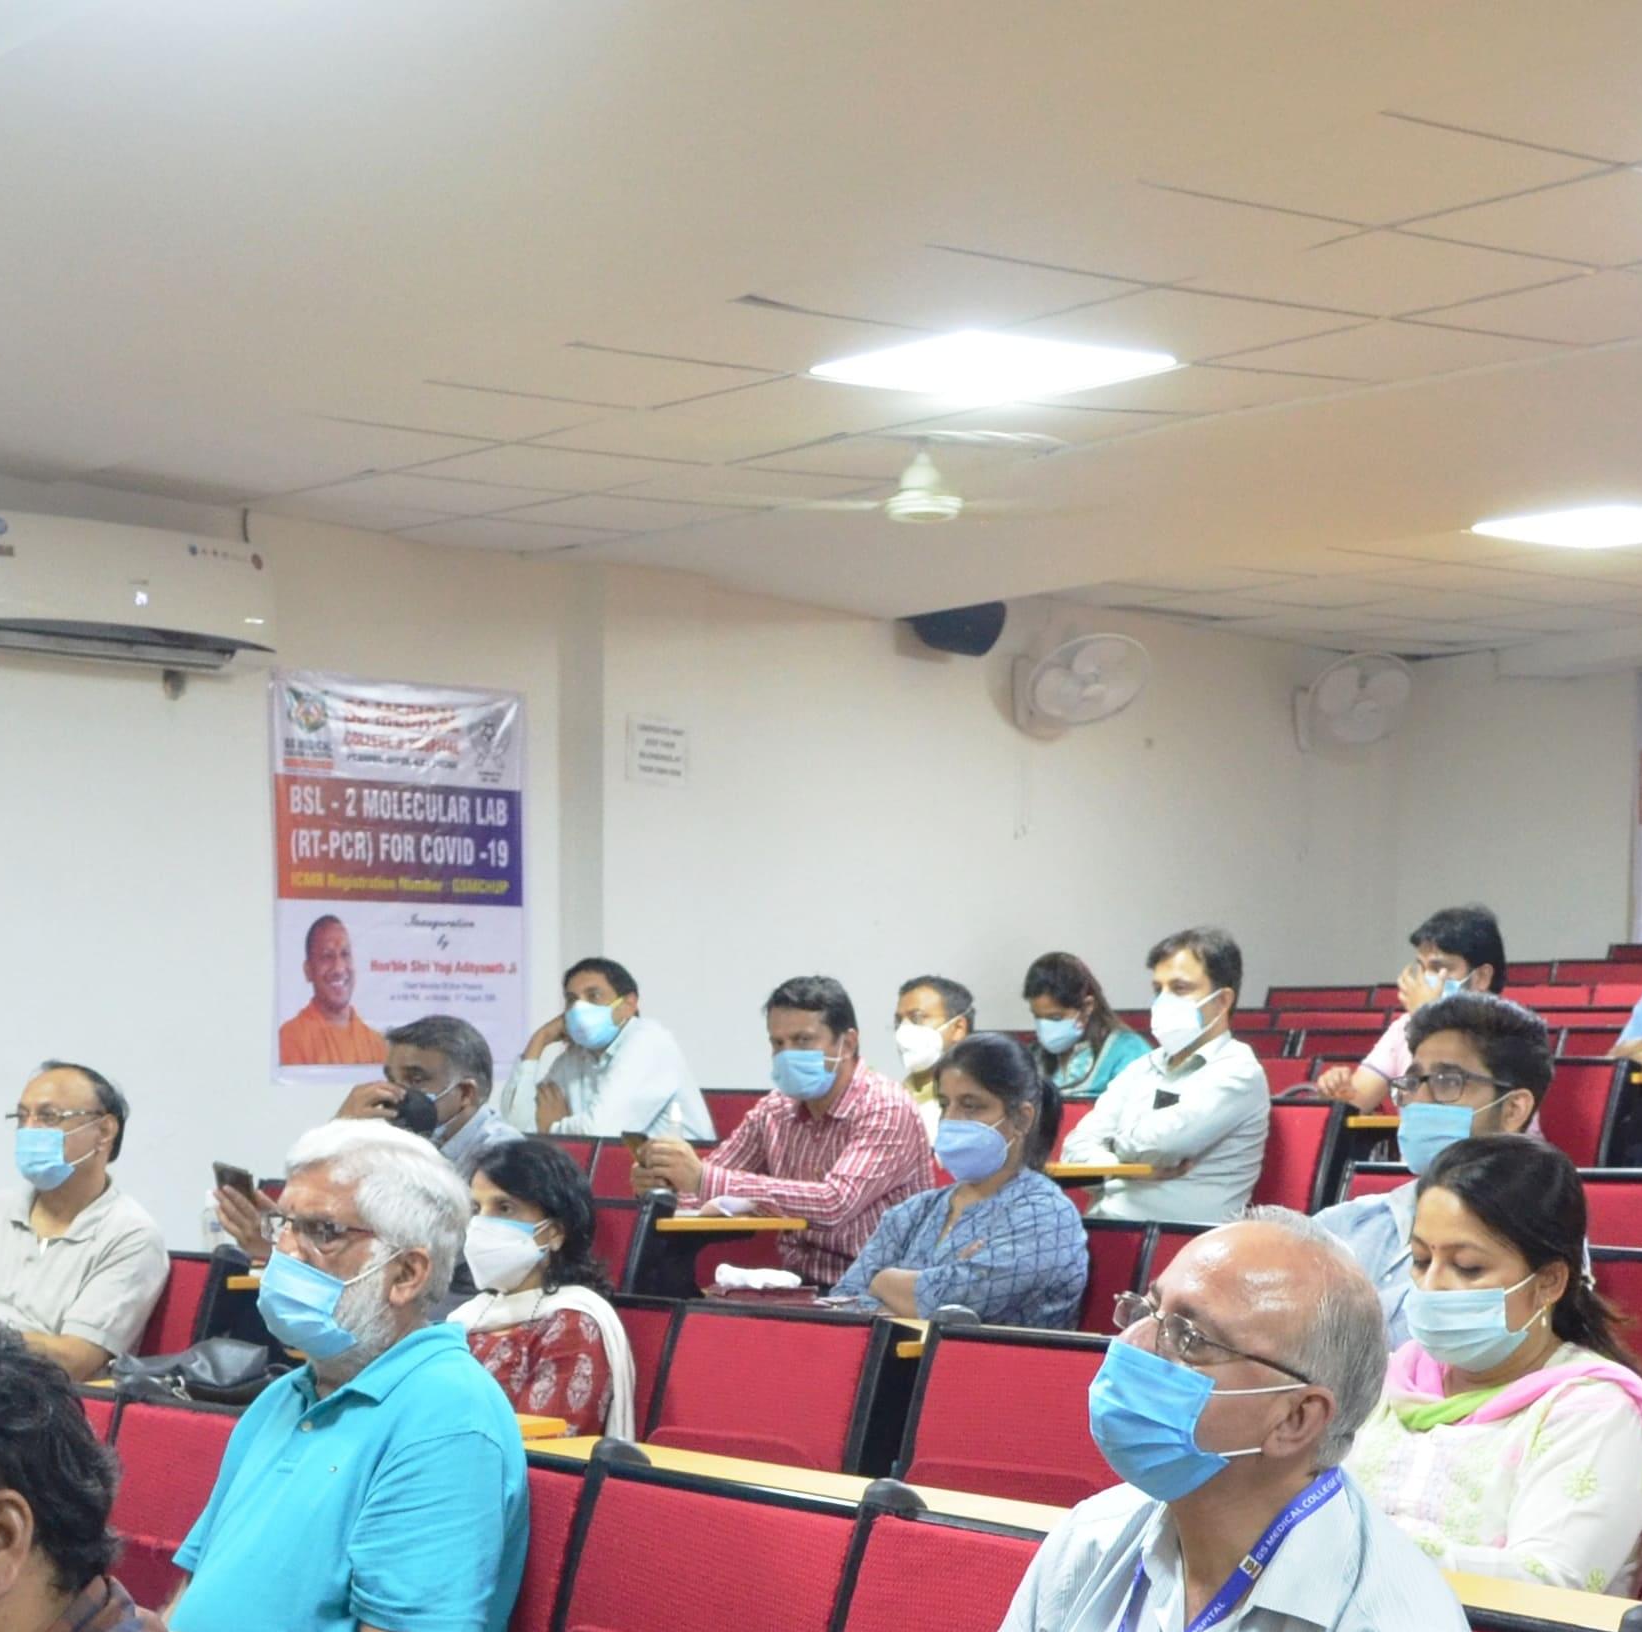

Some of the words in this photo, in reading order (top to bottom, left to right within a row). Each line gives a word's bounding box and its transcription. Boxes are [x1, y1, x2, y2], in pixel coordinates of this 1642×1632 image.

[290, 786, 325, 816] BSL
[345, 788, 356, 817] 2
[363, 789, 470, 825] MOLECULAR
[476, 797, 509, 827] LAB
[290, 829, 374, 866] (RT-PCR)
[379, 833, 416, 863] FOR
[421, 834, 475, 865] COVID
[480, 839, 510, 867] -19
[1256, 1544, 1269, 1561] GS
[1266, 1506, 1304, 1548] MEDICAL
